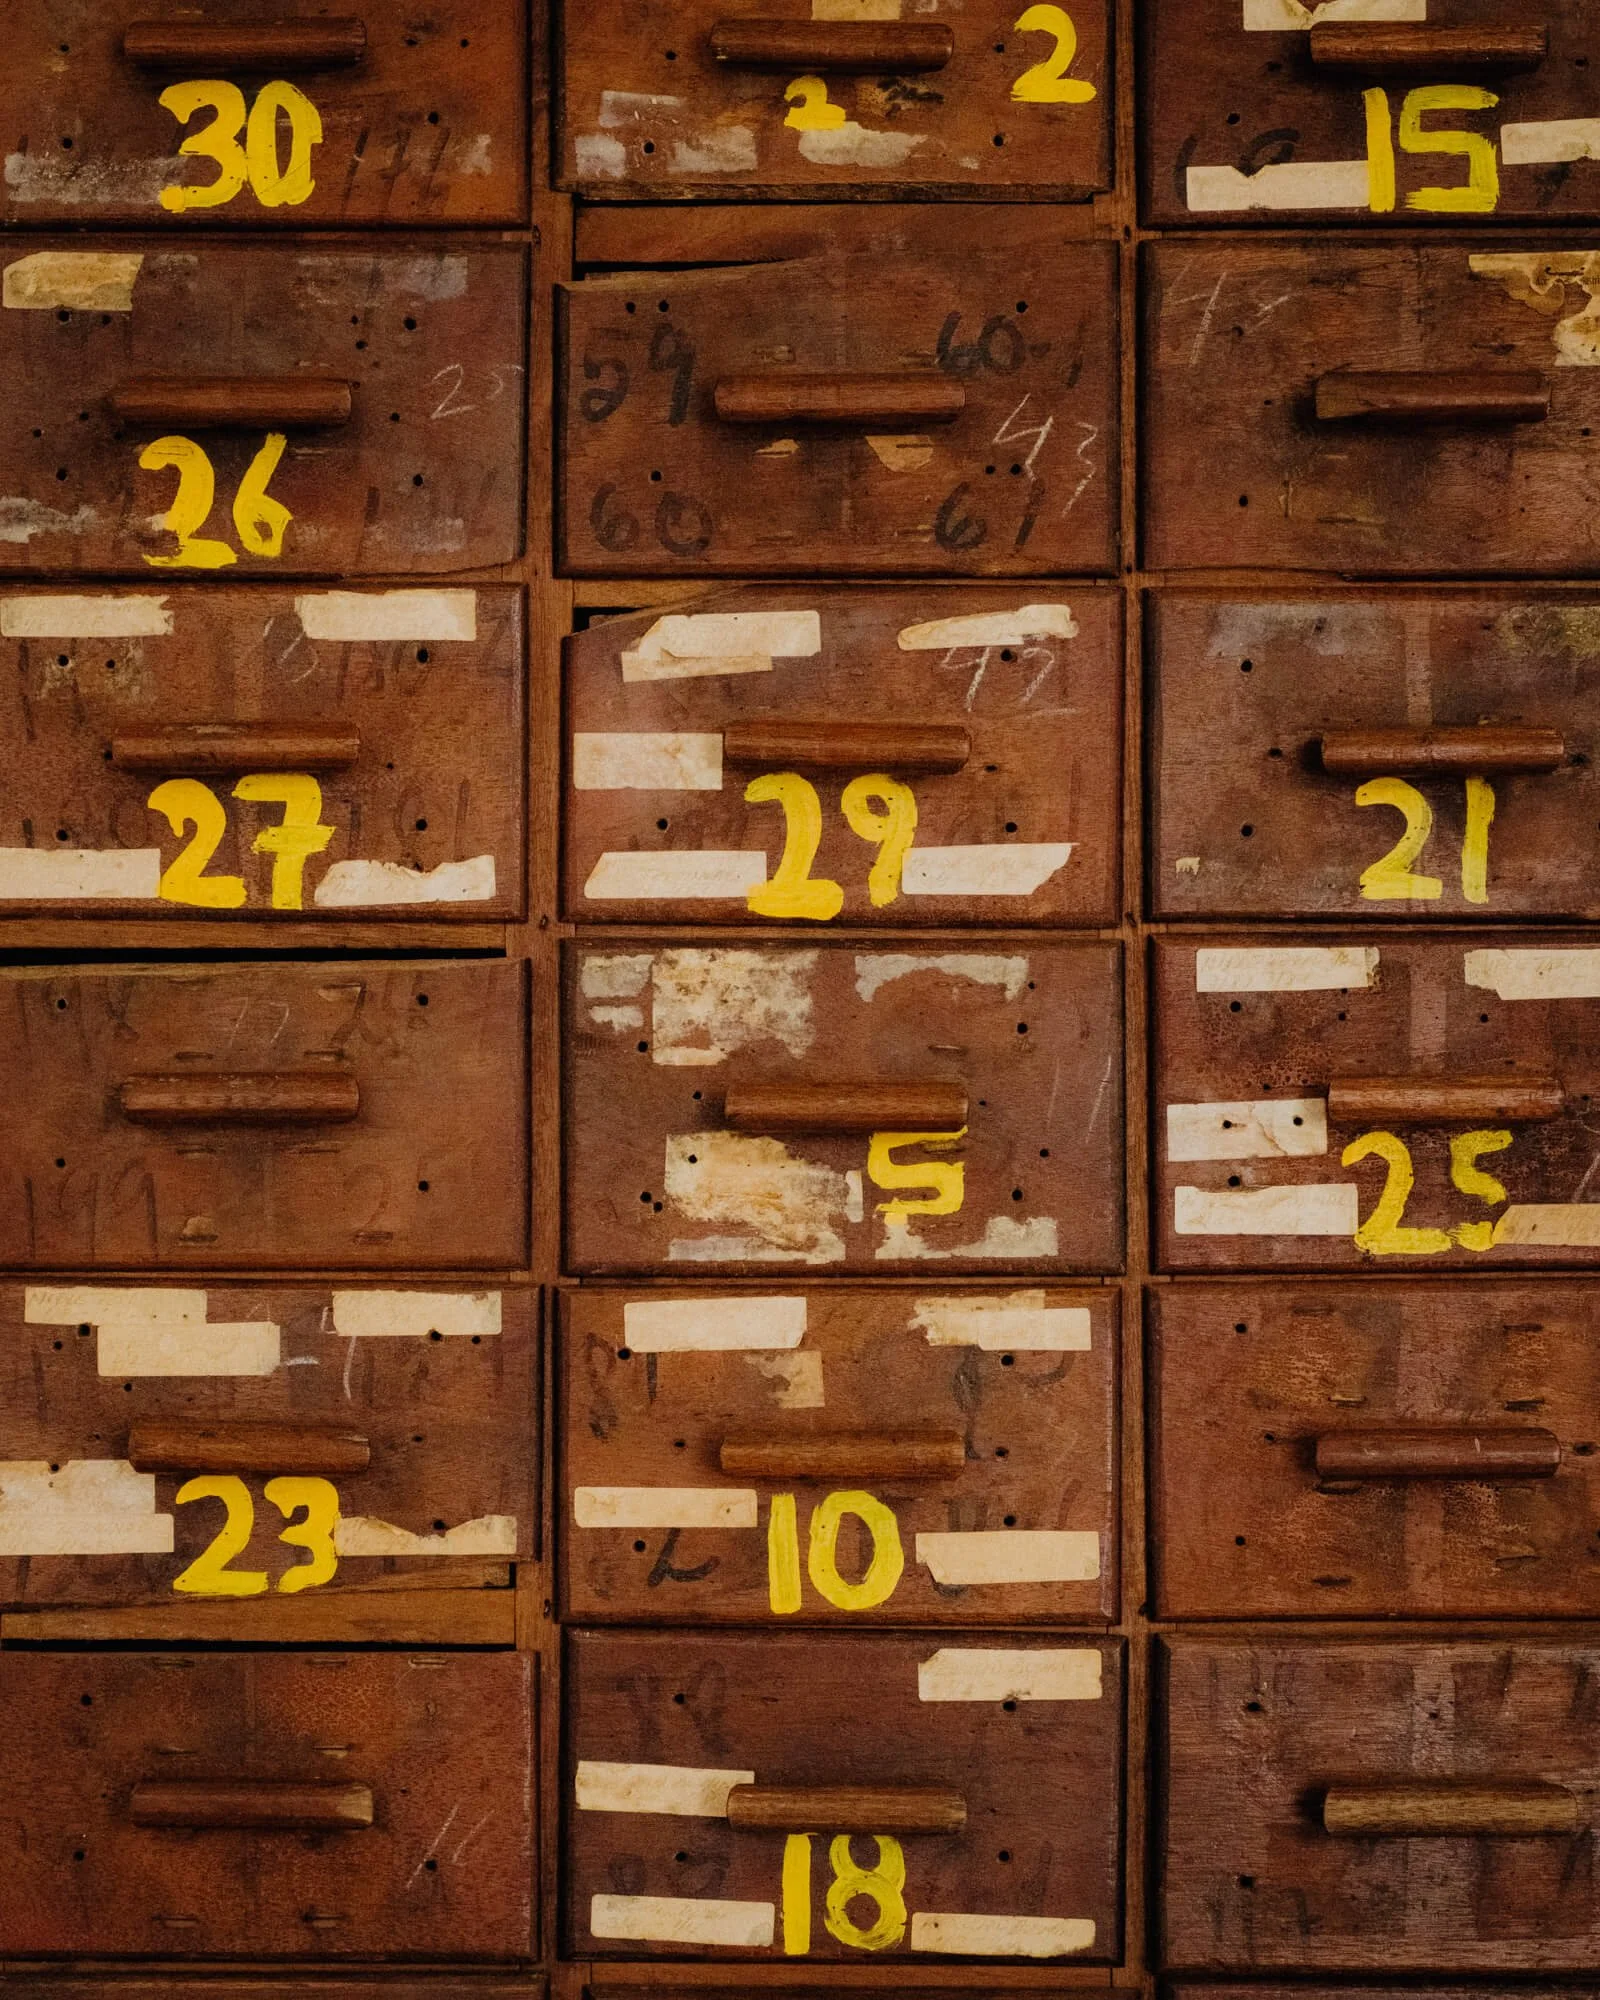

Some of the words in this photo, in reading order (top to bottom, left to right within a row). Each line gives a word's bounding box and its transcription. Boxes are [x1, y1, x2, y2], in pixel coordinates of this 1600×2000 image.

[783, 75, 847, 130] 2
[1010, 4, 1097, 103] 2
[158, 80, 323, 213] 30
[1363, 85, 1499, 213] 15
[139, 432, 292, 568] 26
[147, 773, 336, 909] 27
[744, 773, 918, 920] 29
[1355, 776, 1496, 904] 21
[1342, 1130, 1513, 1255] 25
[173, 1475, 340, 1596] 23
[767, 1490, 905, 1614] 10
[781, 1832, 907, 1955] 18
